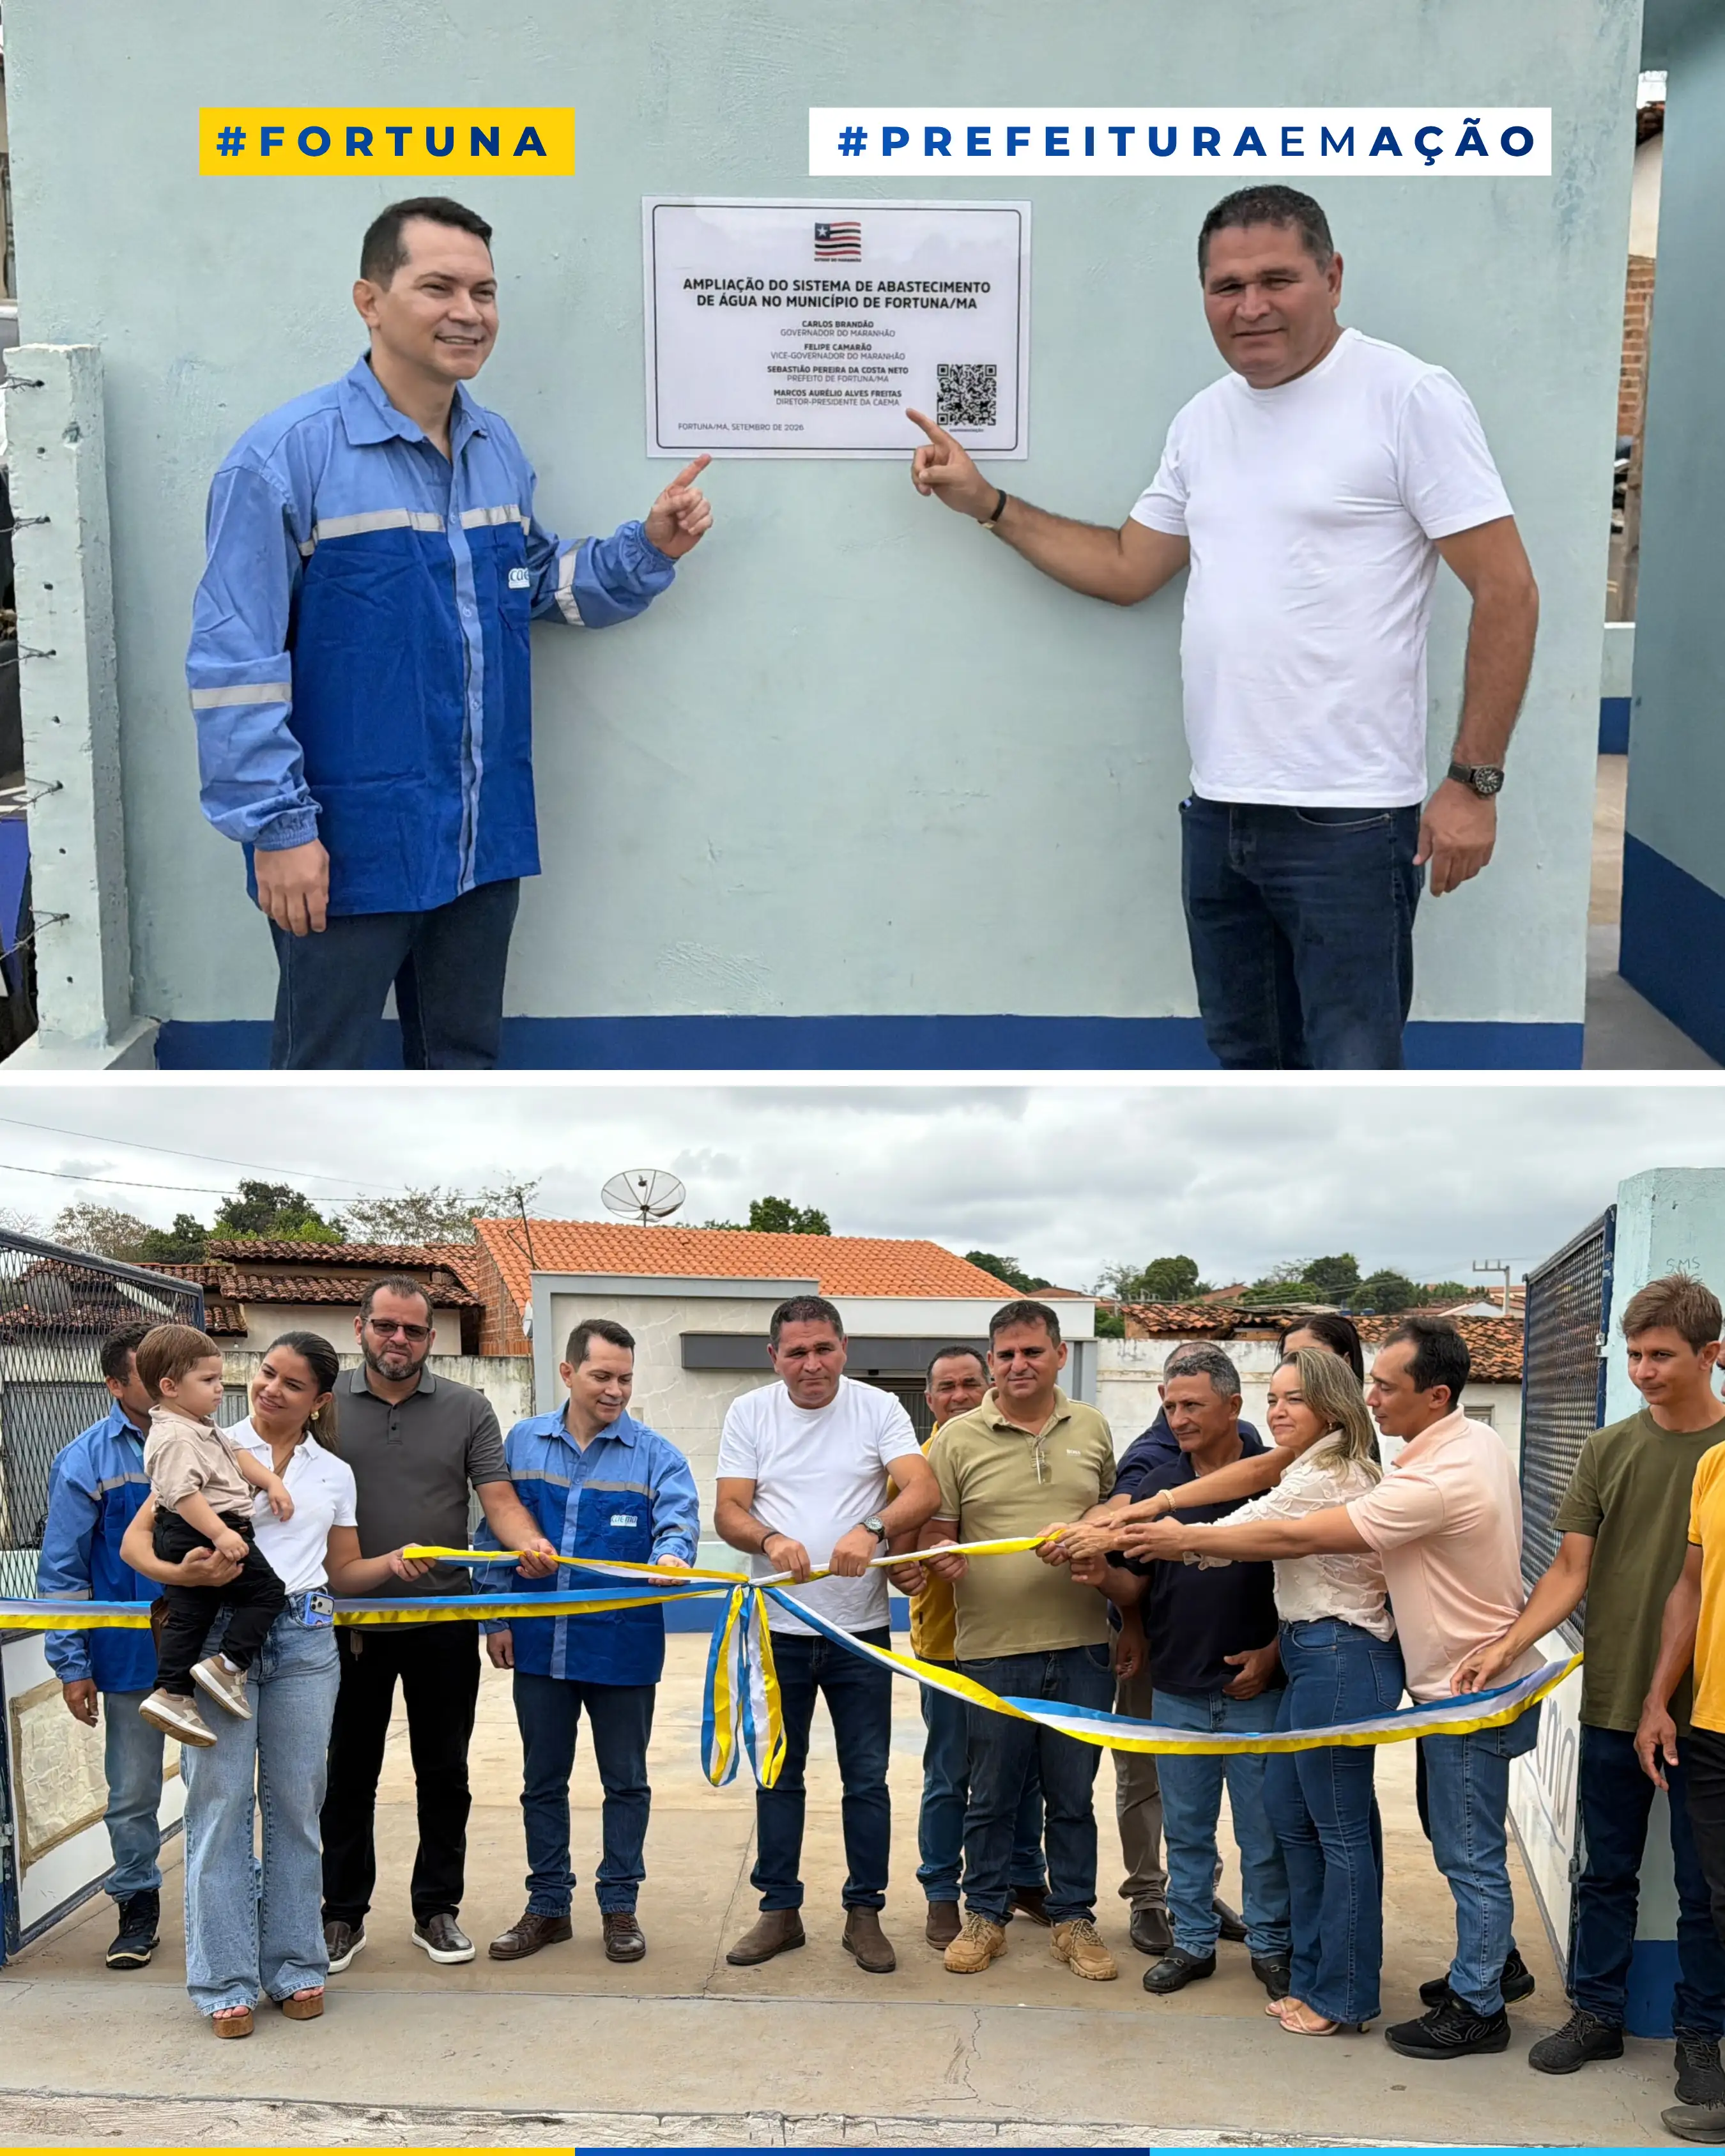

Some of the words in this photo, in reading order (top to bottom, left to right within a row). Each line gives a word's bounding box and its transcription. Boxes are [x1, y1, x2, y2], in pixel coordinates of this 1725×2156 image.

[683, 277, 765, 293] AMPLIAÇÃO
[769, 279, 788, 291] DO
[793, 279, 851, 293] SISTEMA
[855, 280, 873, 292] DE
[877, 280, 991, 293] ABASTECIMENTO
[697, 294, 715, 306] DE
[719, 292, 758, 307] ÁGUA
[762, 295, 782, 307] NO
[786, 293, 859, 308] MUNICÍPIO
[863, 296, 880, 308] DE
[885, 296, 977, 310] FORTUNA/MA
[835, 319, 874, 328] BRANDÃO
[832, 343, 872, 351] CAMARÃO
[770, 351, 845, 360] VICE-GOVERNADOR
[861, 352, 905, 360] MARANHÃO
[767, 365, 811, 373] SEBASTIÃO
[808, 388, 843, 397] AURÉLIO
[678, 423, 730, 431] FORTUNA/MA,
